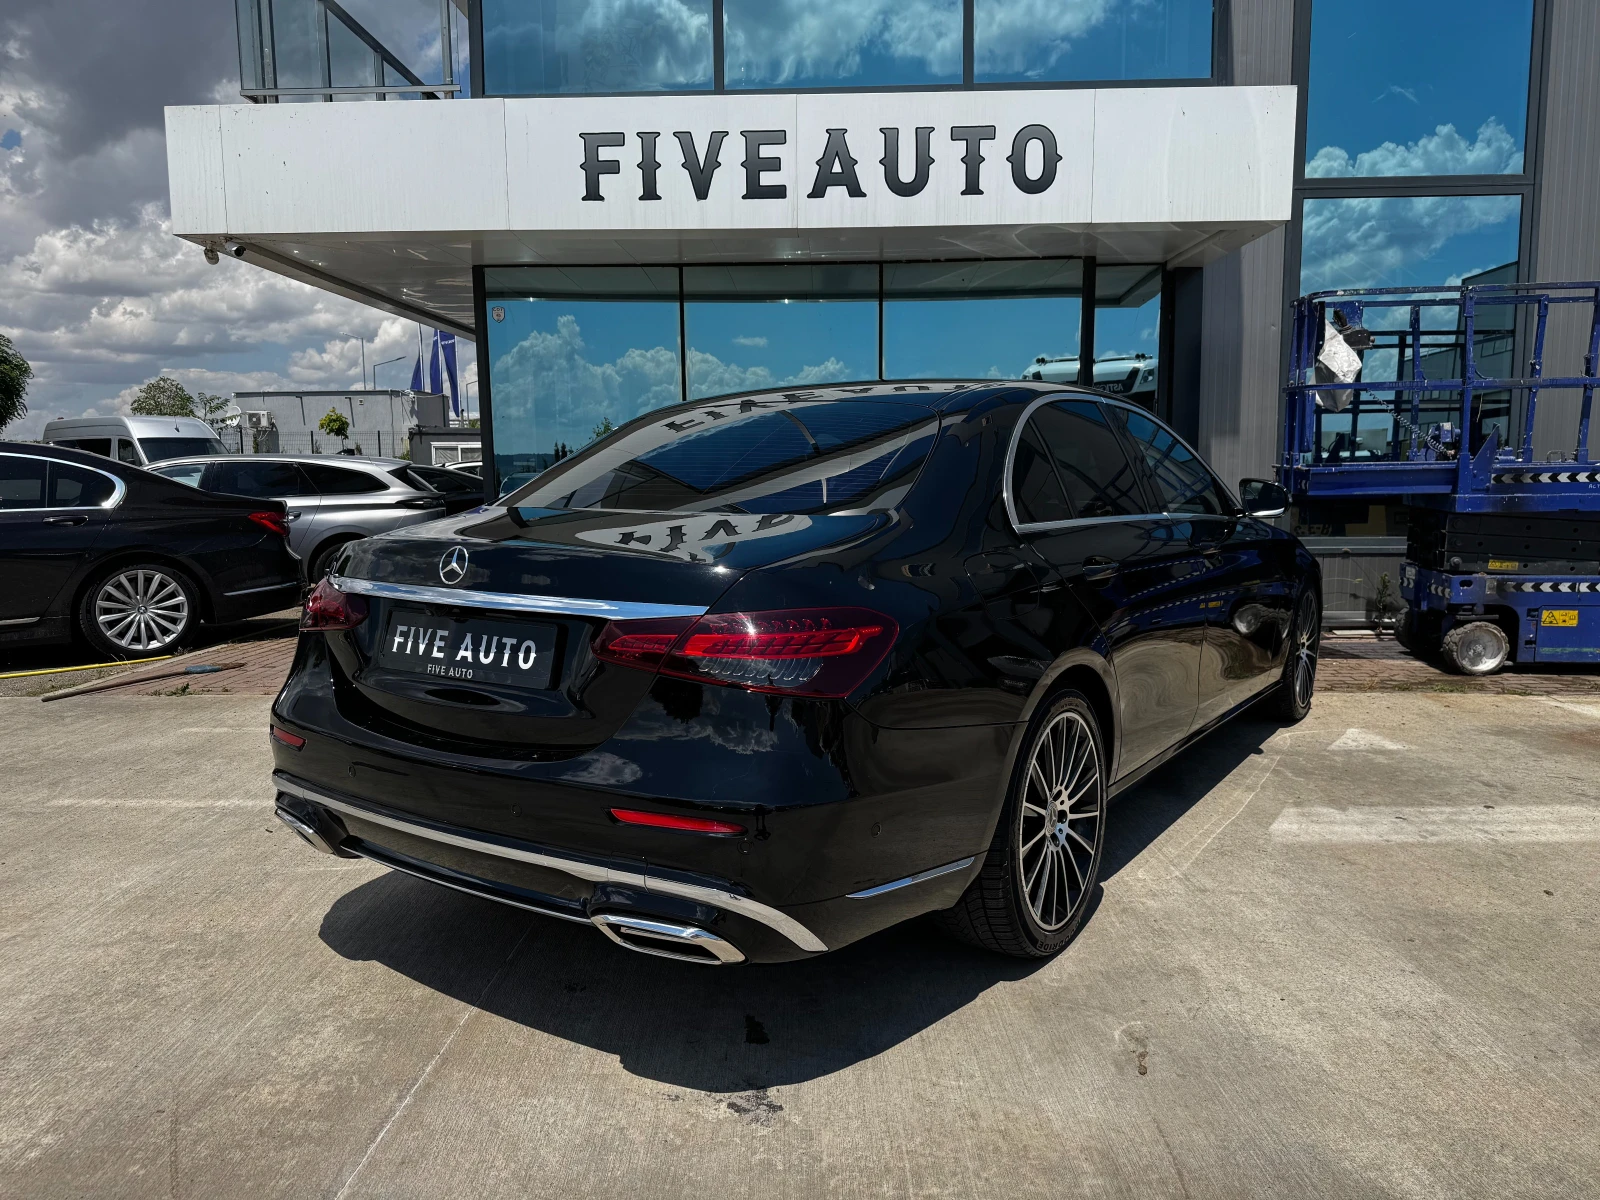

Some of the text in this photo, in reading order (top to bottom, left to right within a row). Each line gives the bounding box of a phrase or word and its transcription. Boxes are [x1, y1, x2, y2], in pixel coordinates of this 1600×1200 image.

[391, 624, 537, 670] FIVE AUTO
[427, 663, 473, 679] FIVE AUTO
